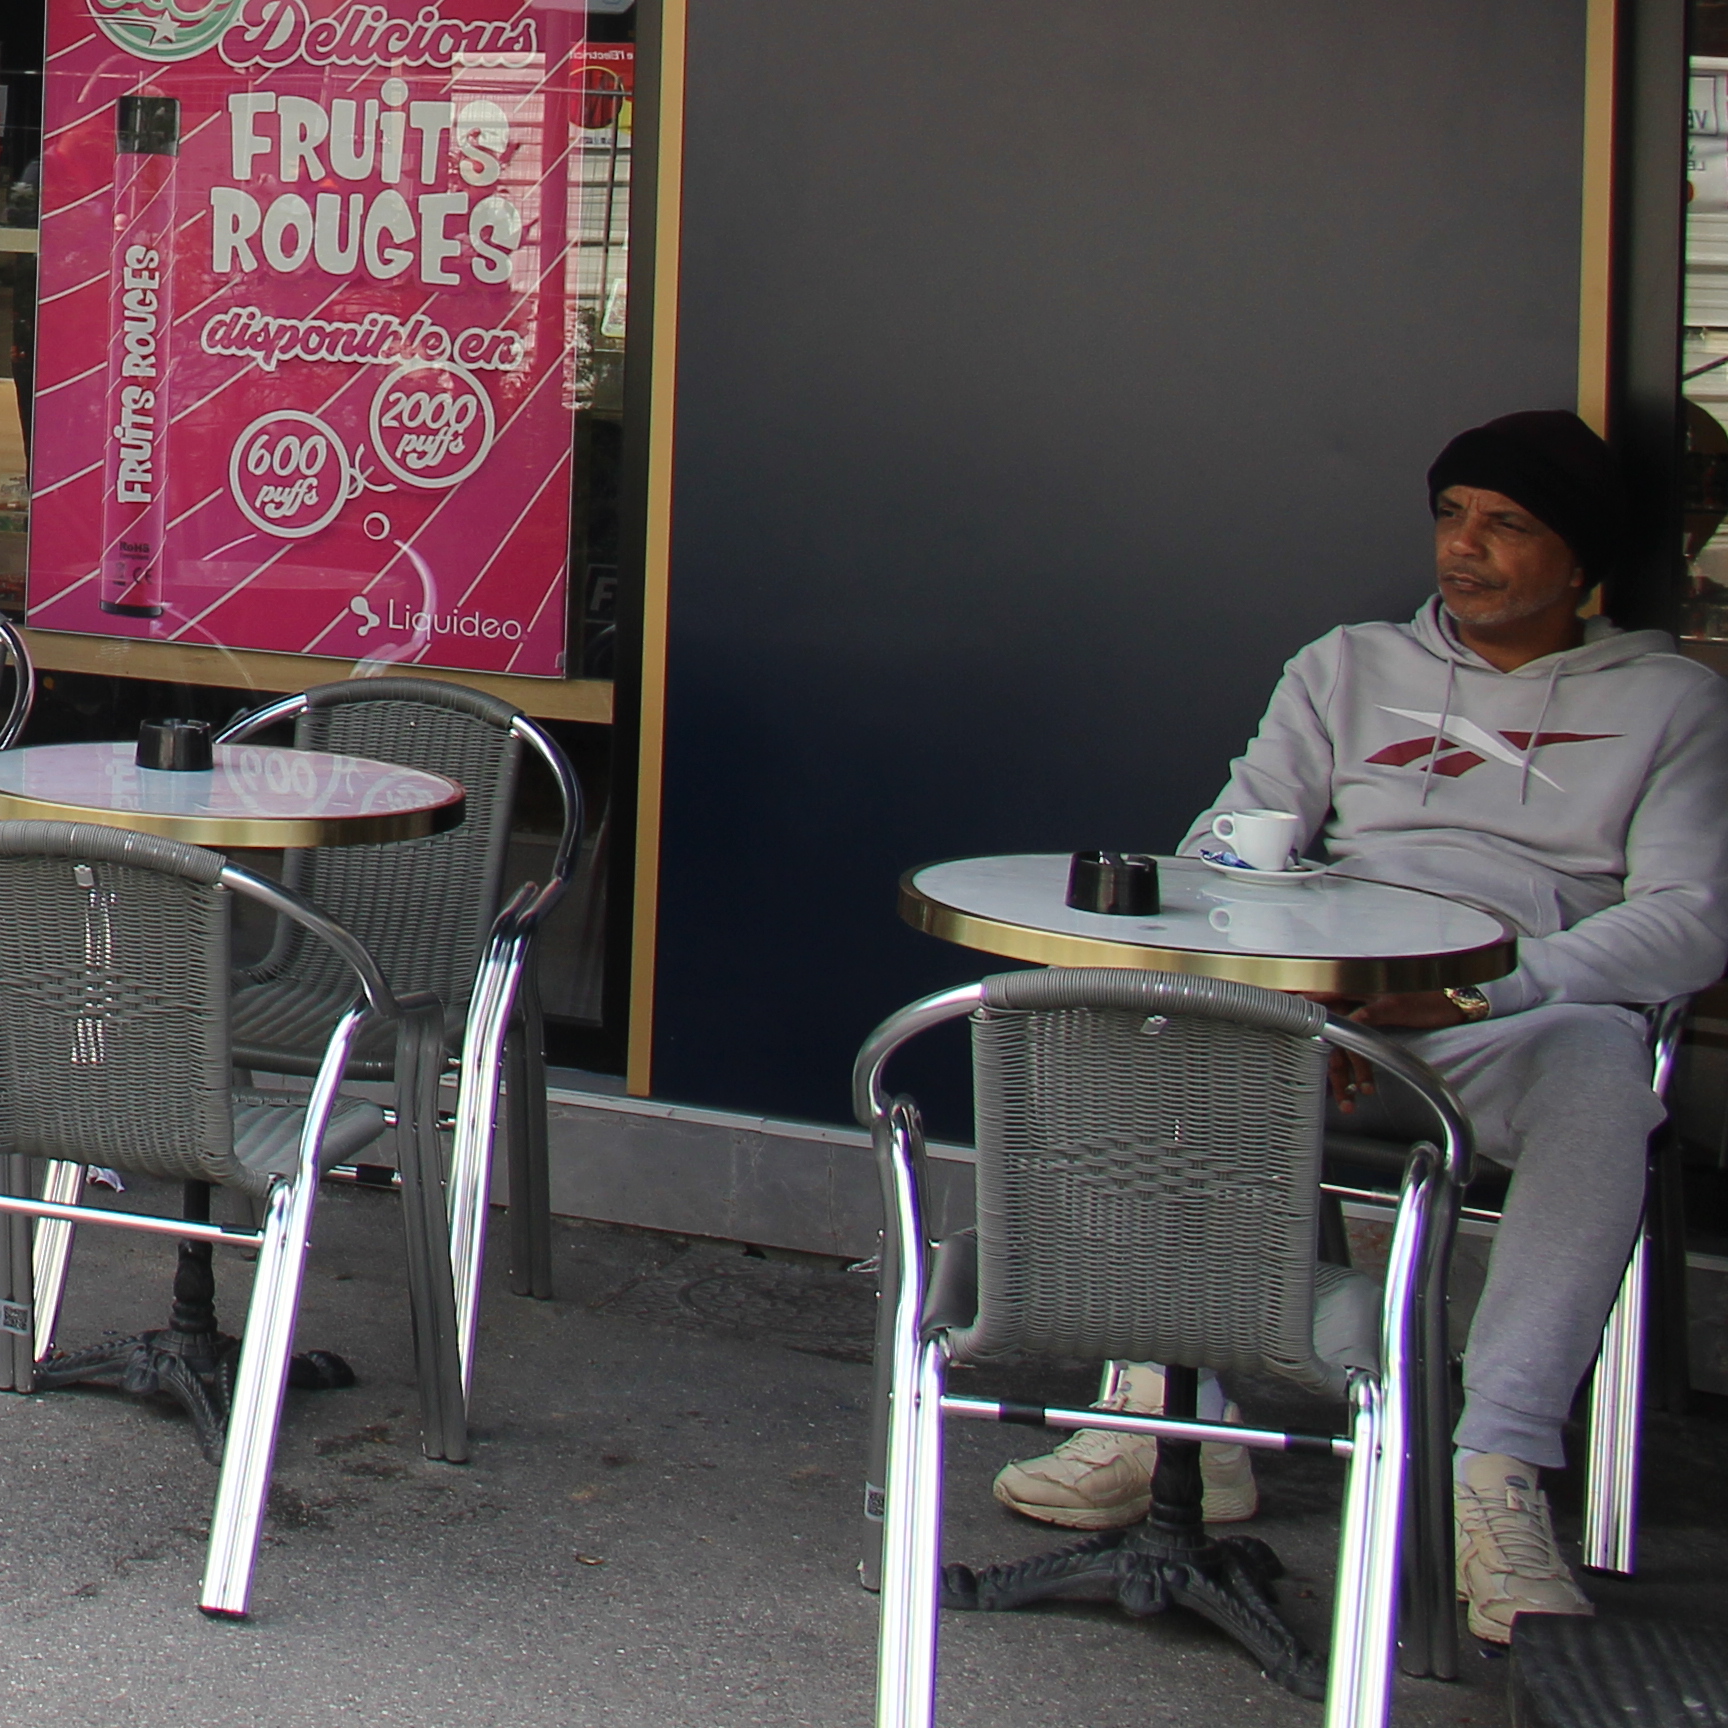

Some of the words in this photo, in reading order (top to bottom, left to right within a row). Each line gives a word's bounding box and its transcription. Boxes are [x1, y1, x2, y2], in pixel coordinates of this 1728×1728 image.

[211, 188, 523, 287] ROUGES
[122, 243, 160, 379] ROUGES
[201, 306, 447, 371] disponible
[451, 328, 524, 371] en
[382, 391, 476, 432] 2000
[247, 434, 326, 478] 600
[395, 423, 465, 469] puffs
[256, 477, 319, 518] puffs
[388, 598, 523, 643] Liquideo
